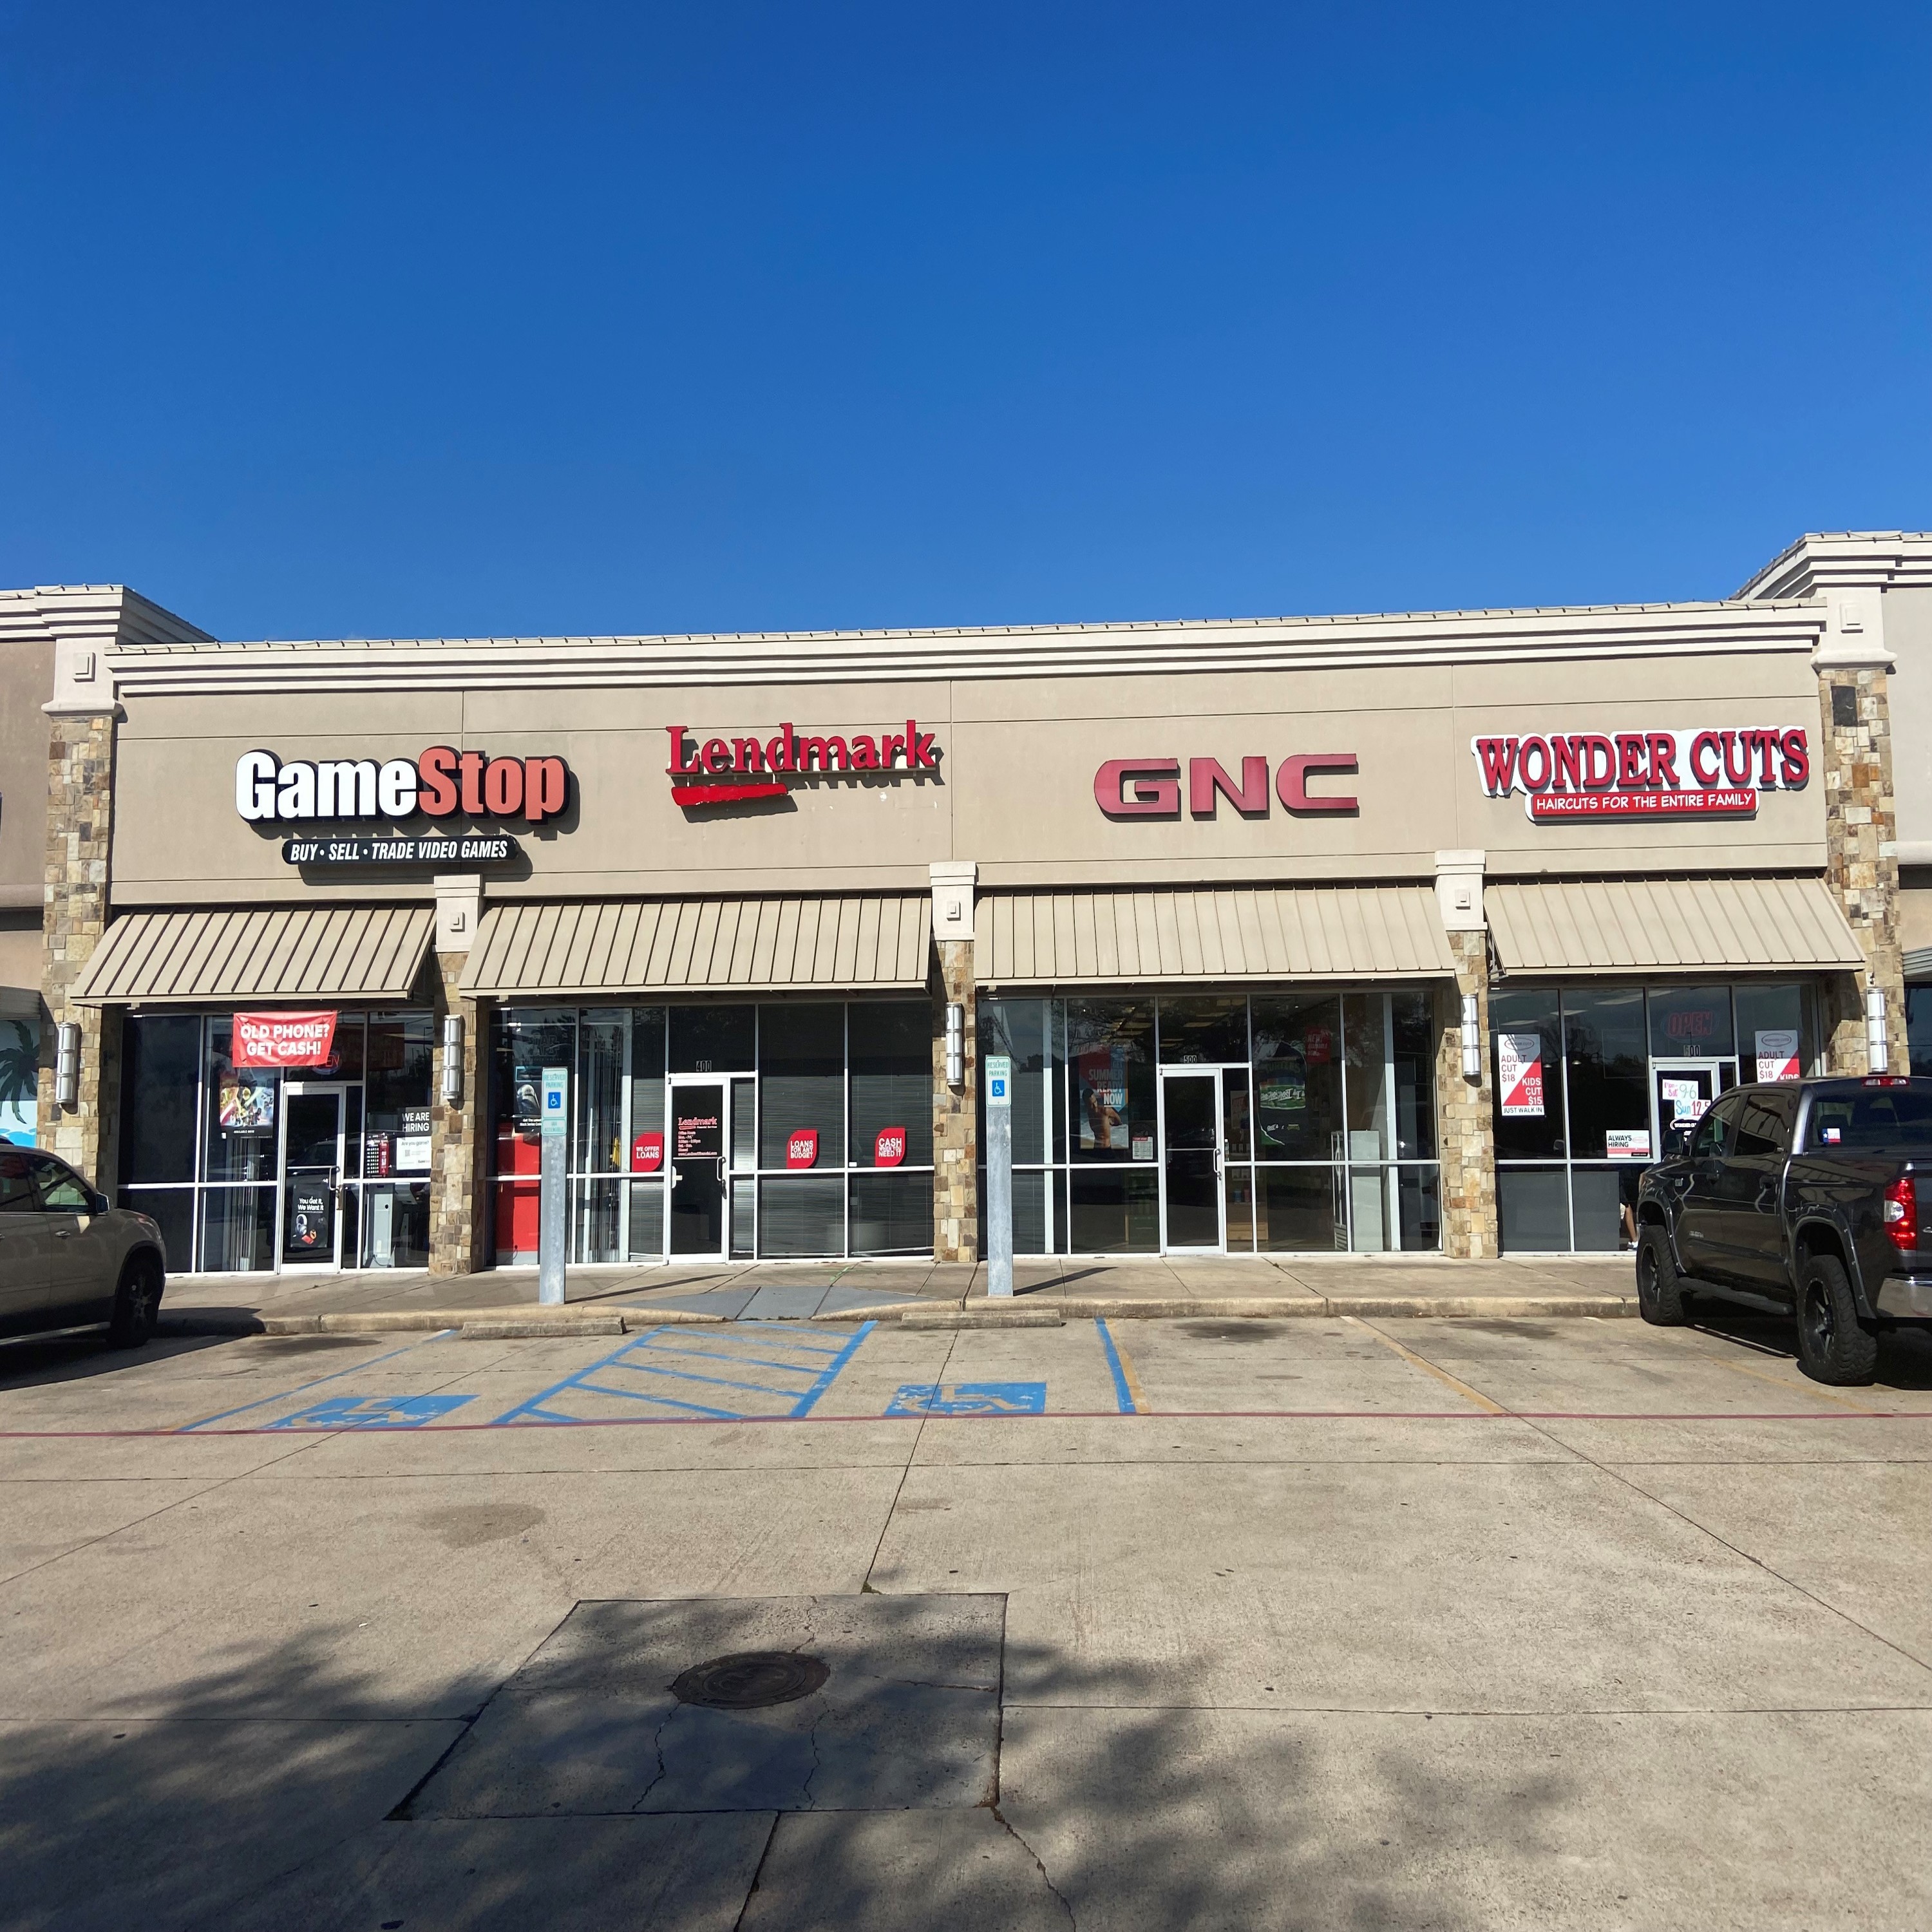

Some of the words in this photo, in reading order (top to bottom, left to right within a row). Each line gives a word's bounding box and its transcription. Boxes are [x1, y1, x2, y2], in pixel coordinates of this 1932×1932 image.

[666, 720, 935, 773] Lendmark
[1477, 733, 1680, 790] WONDER
[1690, 729, 1809, 784] CUTS
[236, 748, 564, 820] GameStop
[1094, 753, 1358, 814] GNC
[1536, 797, 1598, 811] HAIRCUTS
[1602, 796, 1629, 809] FOR
[1633, 795, 1658, 808] THE
[1662, 794, 1704, 808] ENTIRE
[1707, 792, 1753, 806] FAMILY
[290, 844, 319, 861] BUY
[328, 843, 359, 860] SELL
[372, 842, 414, 860] TRADE
[419, 842, 457, 859] VIDEO
[461, 840, 507, 858] GAMES
[240, 1024, 270, 1038] OLD
[273, 1024, 330, 1038] PHONE?
[247, 1041, 275, 1056] GET
[278, 1041, 321, 1056] CASH!
[1759, 1051, 1785, 1059] ADULT
[697, 1061, 711, 1072] 400
[1088, 1069, 1123, 1080] SUMMER
[1502, 1074, 1515, 1083] $18
[1759, 1070, 1774, 1079] $18
[1097, 1081, 1122, 1092] READY
[1522, 1077, 1541, 1086] KIDS
[1104, 1093, 1122, 1104] NOW
[1528, 1096, 1542, 1106] $15
[1676, 1100, 1691, 1115] Sun
[402, 1113, 414, 1121] WE
[415, 1112, 430, 1121] ARE
[402, 1122, 430, 1132] HIRING
[878, 1138, 902, 1146] CASH
